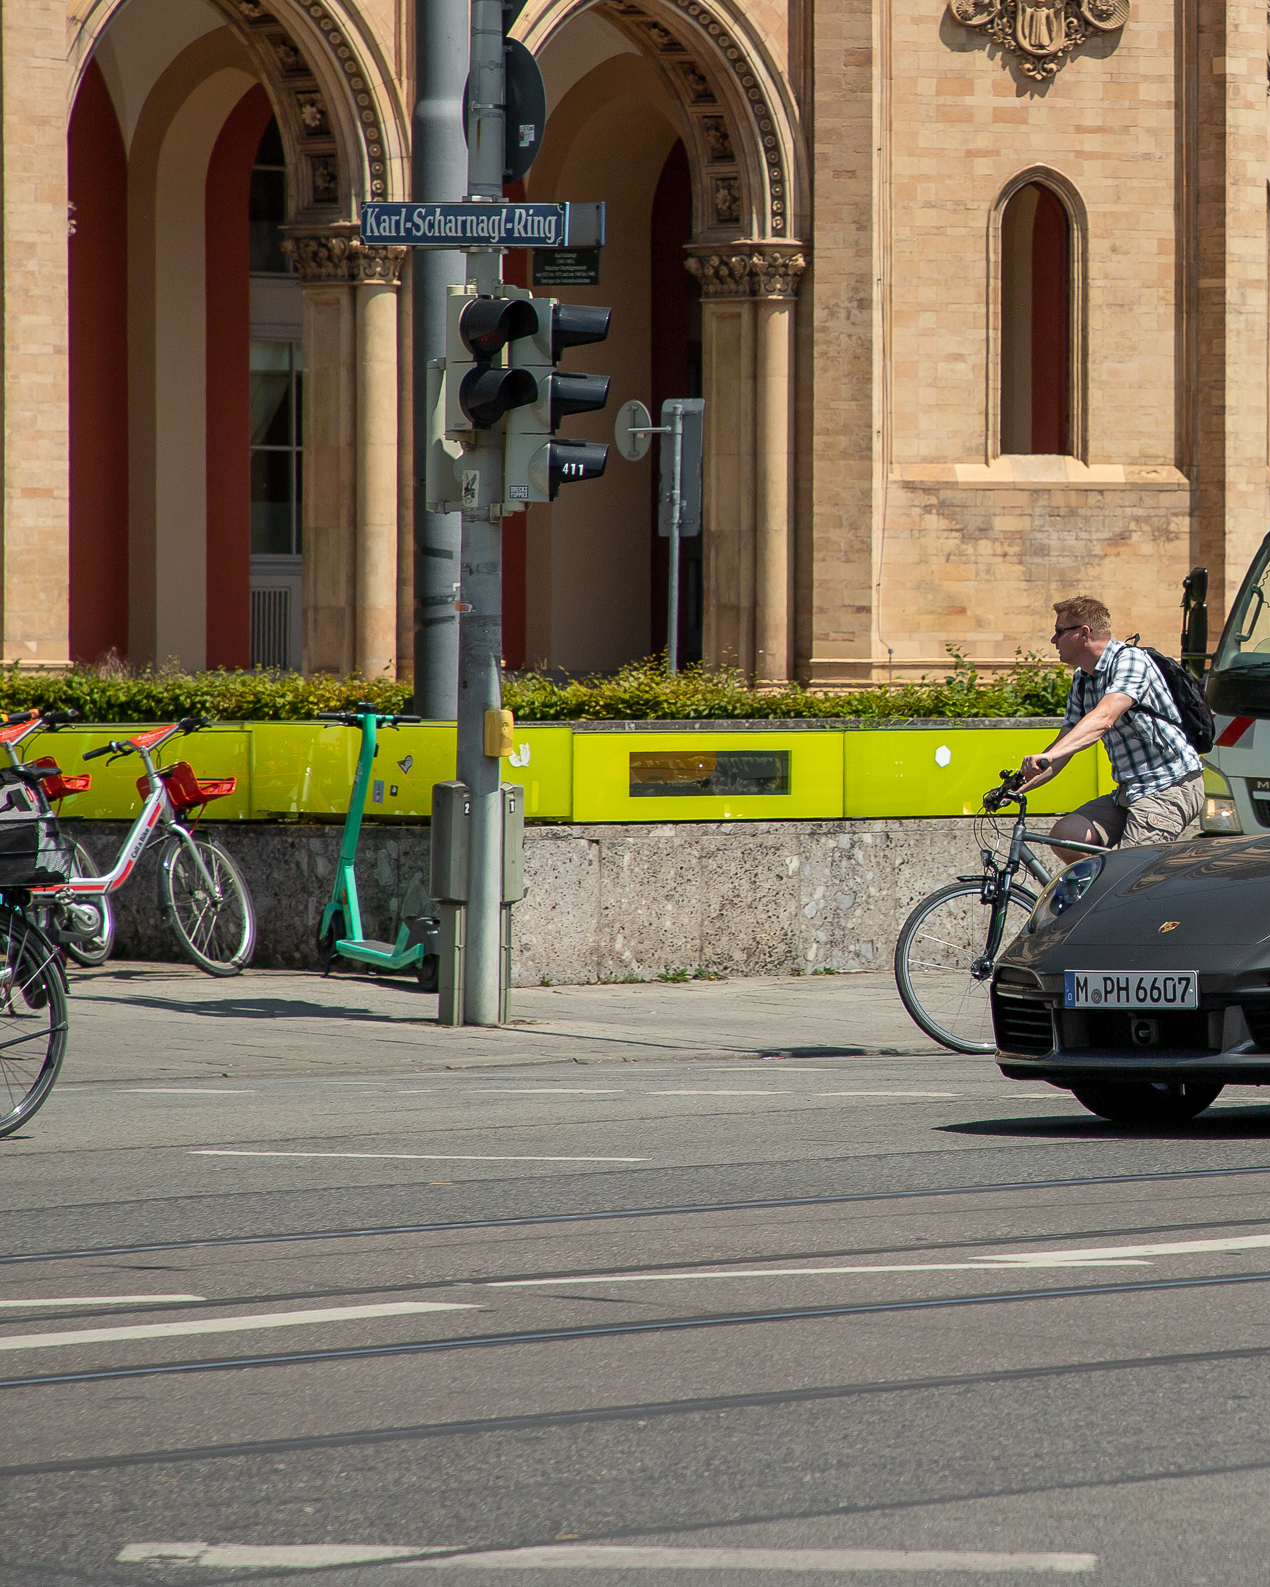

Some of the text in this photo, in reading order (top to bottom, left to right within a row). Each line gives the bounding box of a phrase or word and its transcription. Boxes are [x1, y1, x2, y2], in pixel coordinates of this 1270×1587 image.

[366, 208, 557, 243] Karl-Scharnagl-Ring
[562, 463, 584, 476] 411
[464, 802, 470, 814] 2
[510, 800, 515, 812] 1
[1076, 976, 1191, 1003] M PH 6607
